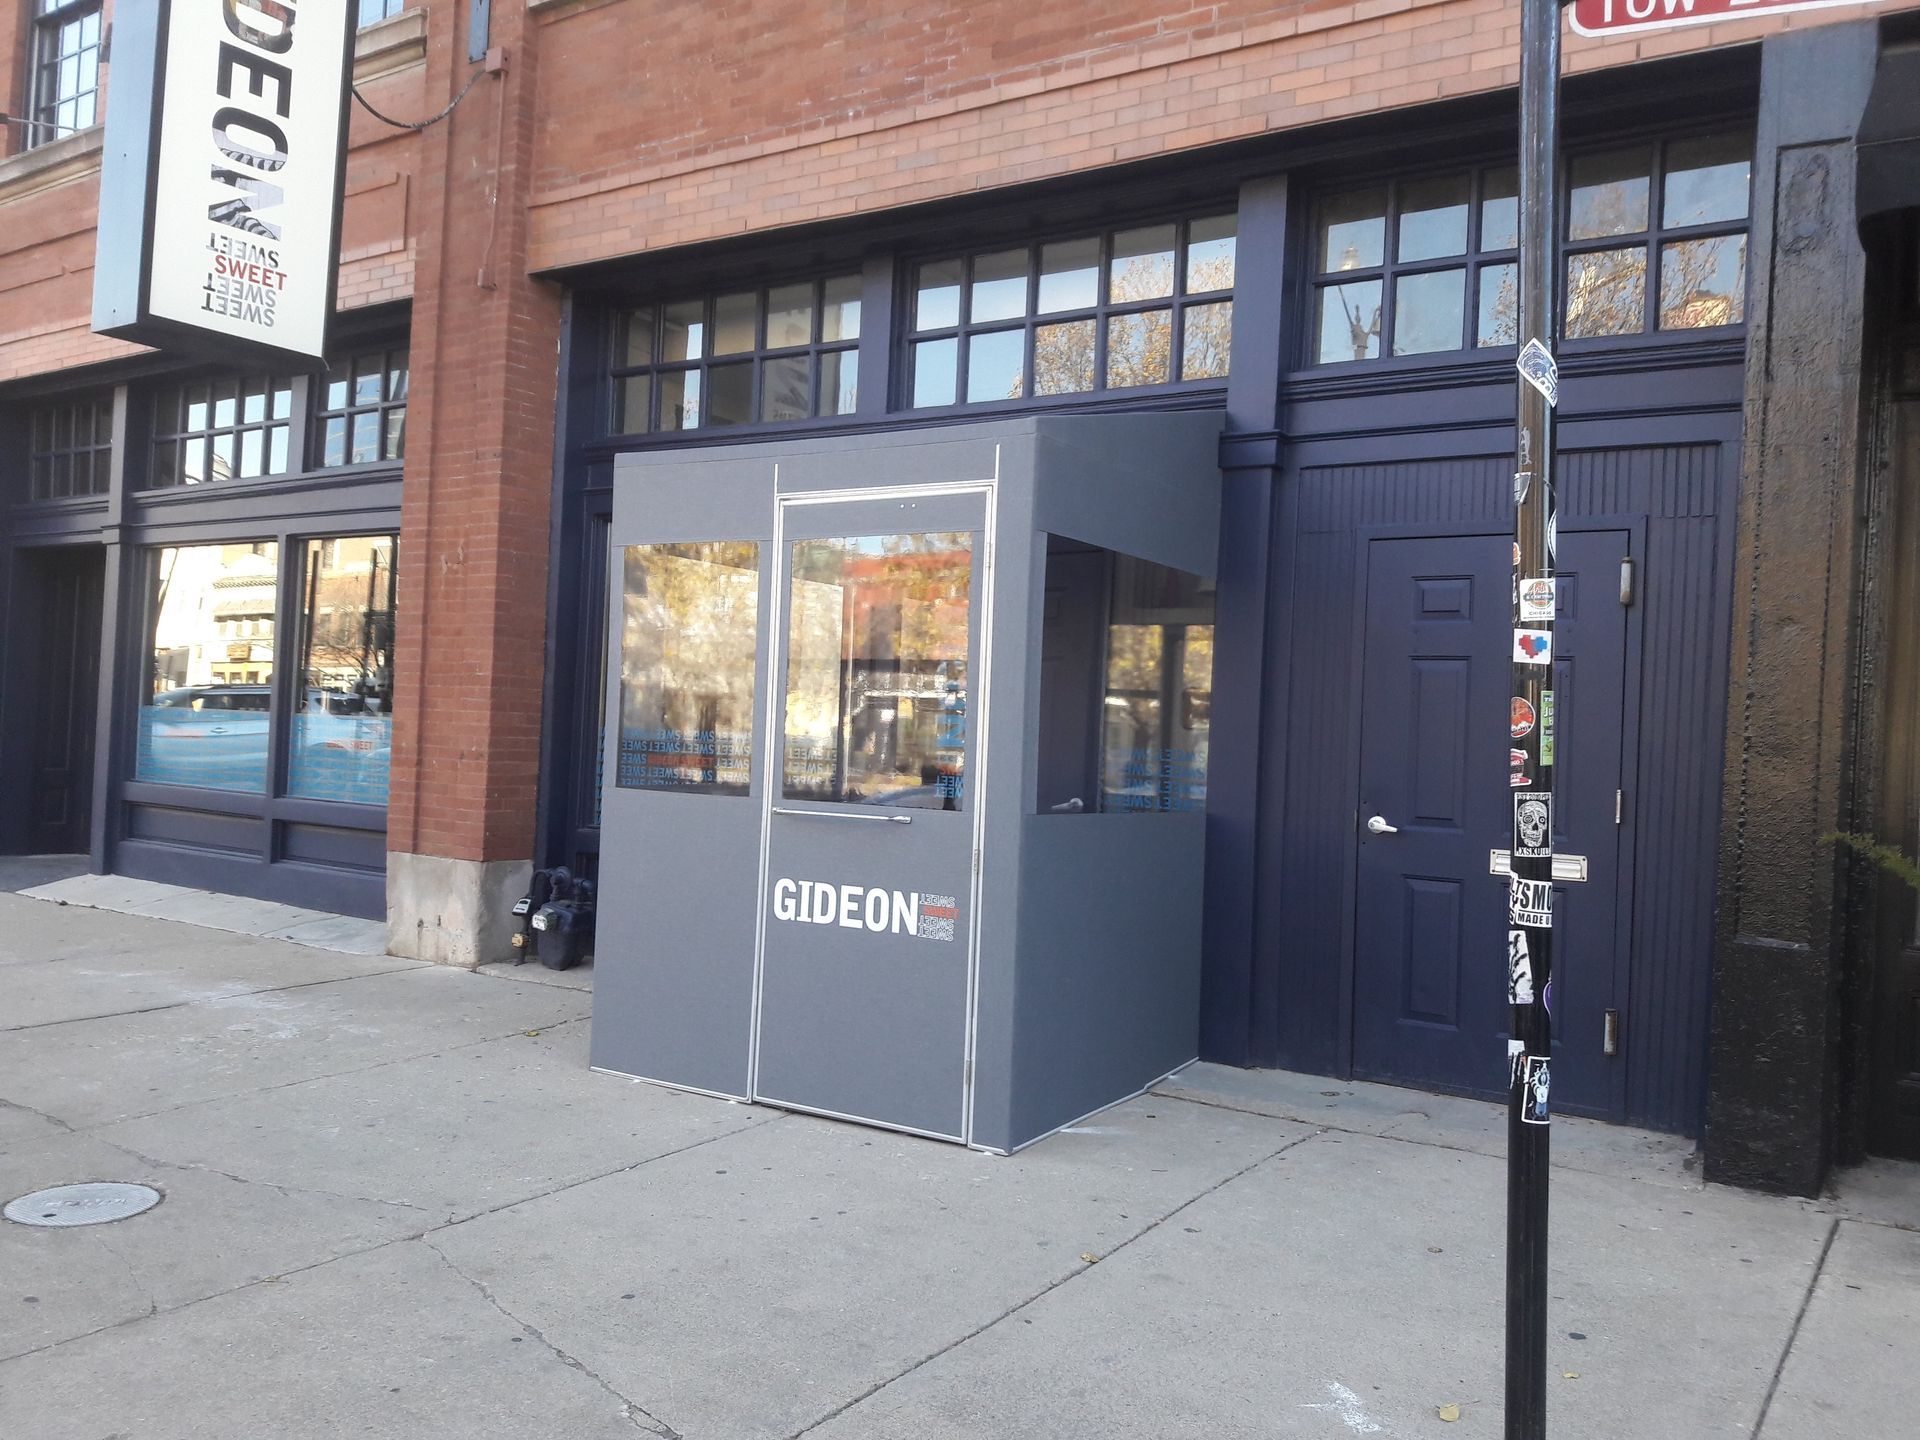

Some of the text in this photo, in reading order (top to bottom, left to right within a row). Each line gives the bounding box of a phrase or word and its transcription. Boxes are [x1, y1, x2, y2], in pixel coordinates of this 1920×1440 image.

[207, 0, 297, 241] DEON
[205, 232, 279, 268] SWEET
[214, 254, 287, 291] SWEET
[202, 272, 276, 308] SWEET
[200, 292, 275, 327] SWEET
[647, 740, 681, 753] SWEET
[681, 742, 715, 755] SWEET
[716, 743, 752, 756] SWEET
[715, 757, 750, 769] SWEET
[647, 767, 679, 780] SWEET
[773, 877, 919, 936] GIDEON
[919, 893, 956, 908] SWEET
[918, 915, 955, 931] SWEET
[1517, 912, 1544, 925] MADE
[917, 925, 954, 942] SWEET
